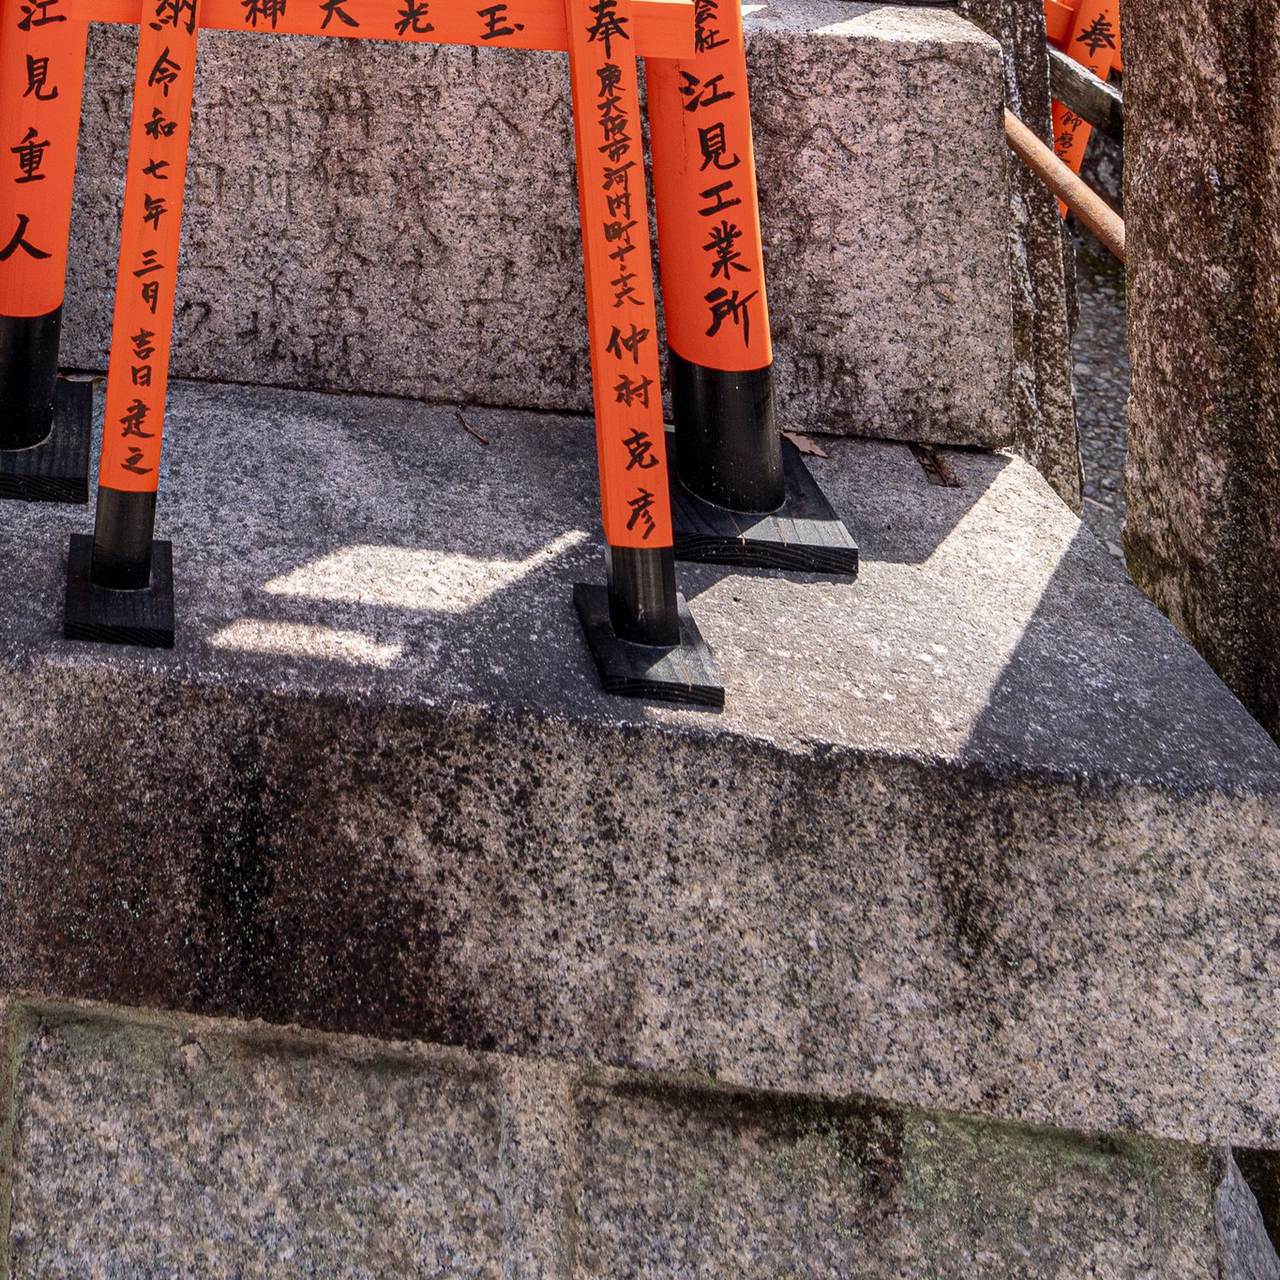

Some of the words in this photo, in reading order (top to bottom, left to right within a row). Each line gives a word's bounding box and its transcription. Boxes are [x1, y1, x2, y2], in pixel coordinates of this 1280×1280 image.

[1075, 12, 1116, 58] 奉
[120, 46, 182, 476] 令和七年三月吉日建之
[679, 71, 758, 348] 江見工業所
